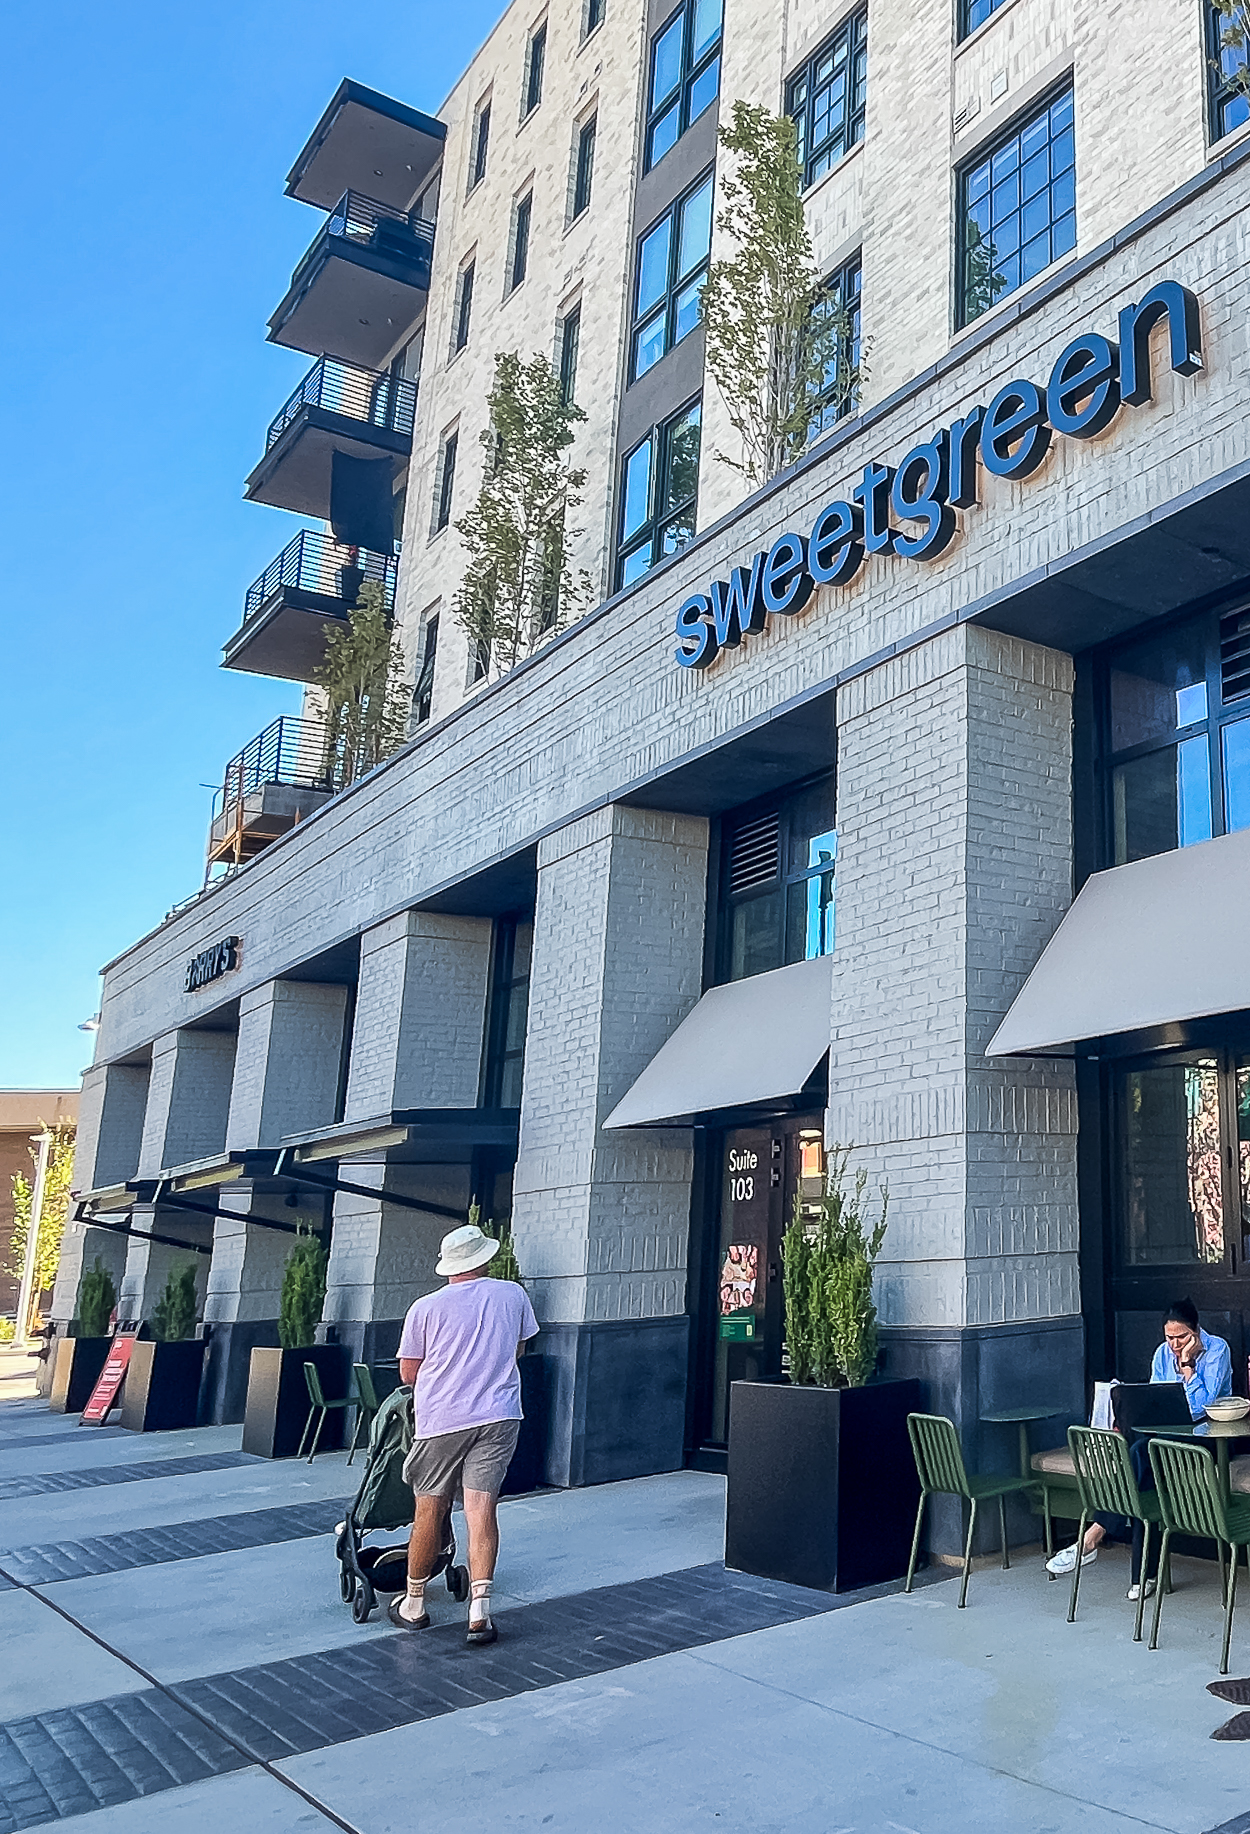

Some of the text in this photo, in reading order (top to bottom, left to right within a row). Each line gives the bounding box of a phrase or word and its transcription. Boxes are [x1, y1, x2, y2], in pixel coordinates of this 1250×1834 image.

[675, 279, 1202, 669] sweetgreen
[729, 1149, 758, 1172] Suite
[731, 1176, 754, 1201] 103
